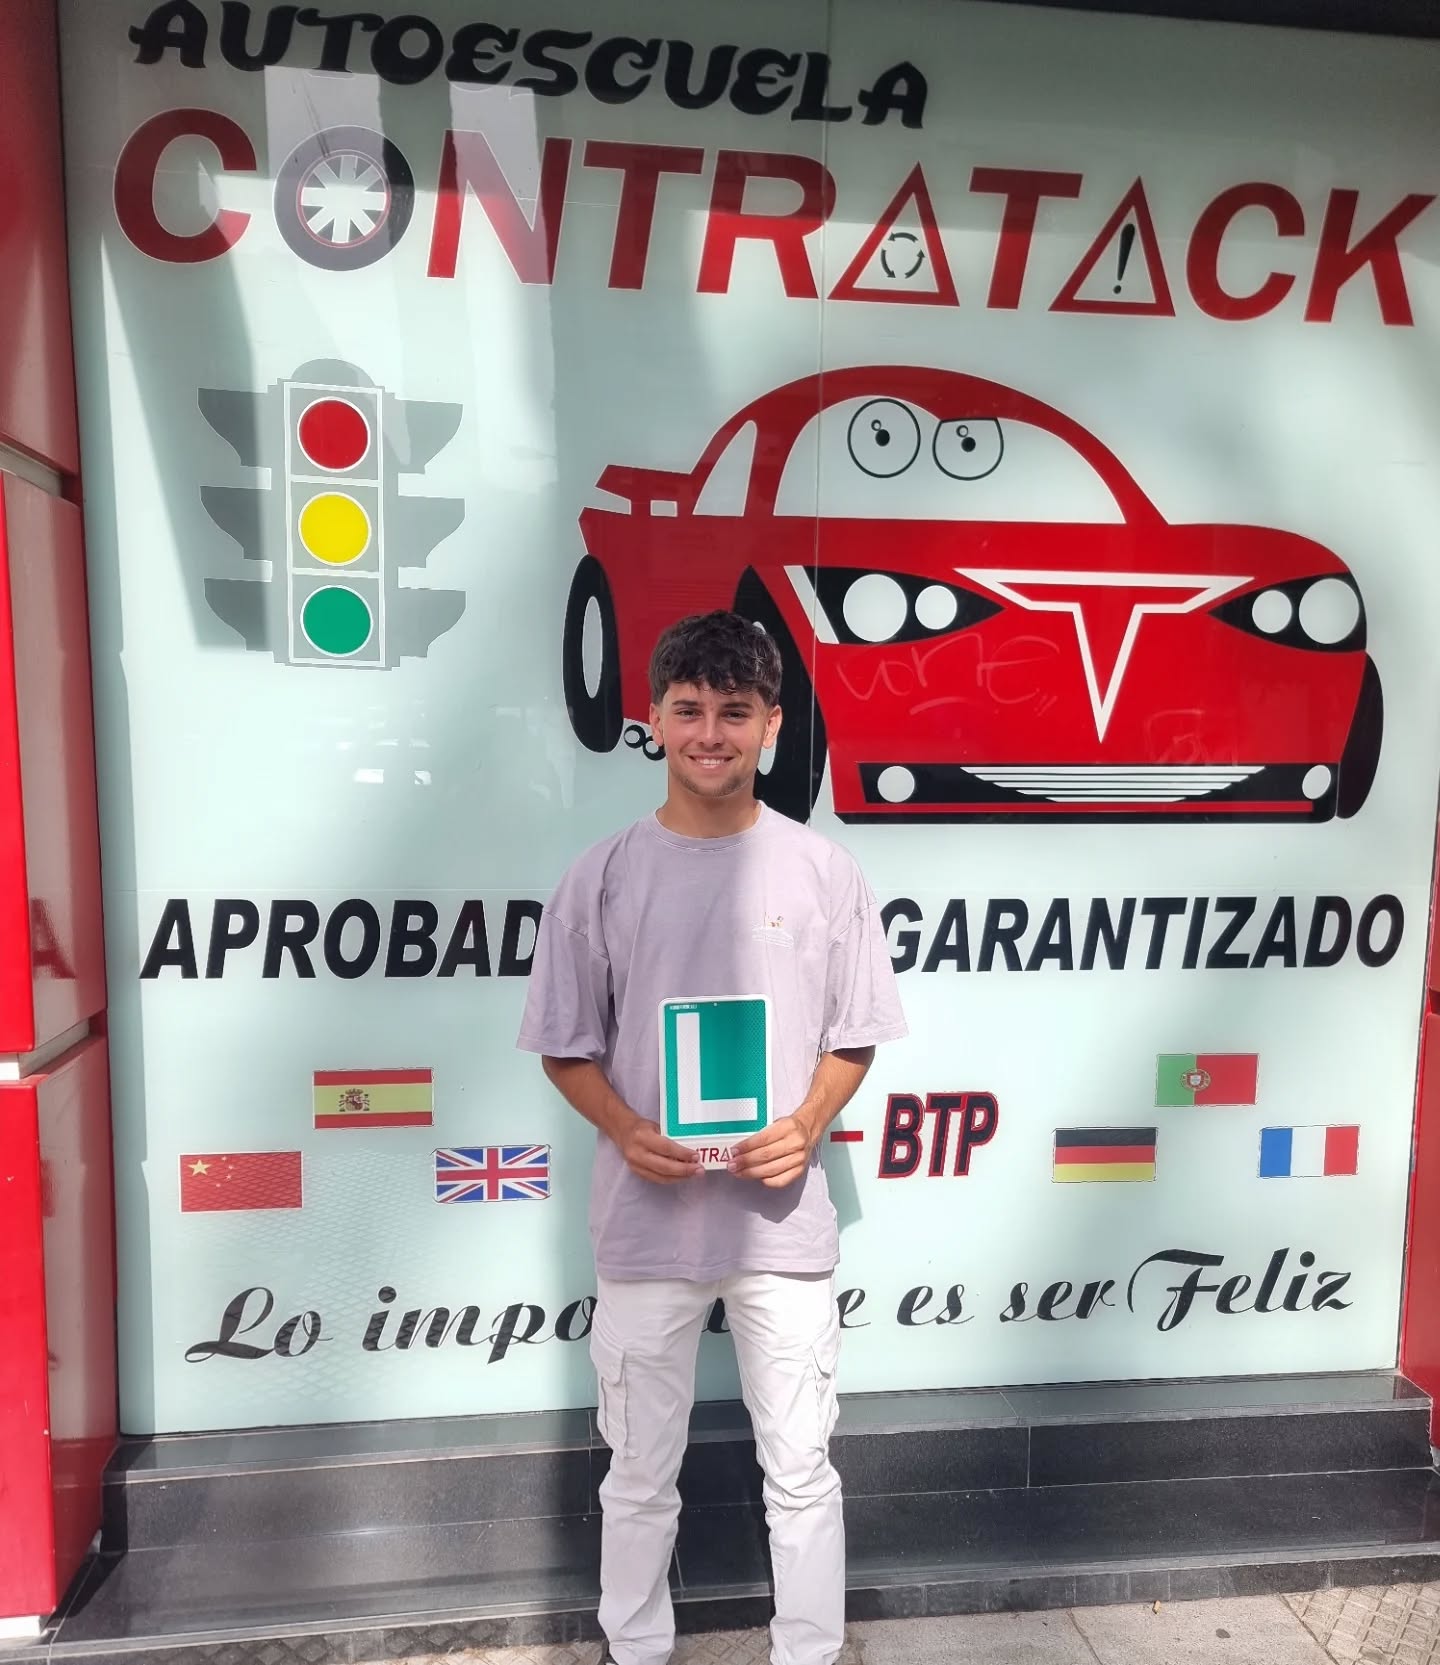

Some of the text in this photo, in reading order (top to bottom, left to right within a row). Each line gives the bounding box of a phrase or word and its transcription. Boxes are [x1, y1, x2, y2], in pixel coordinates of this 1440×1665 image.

[127, 0, 928, 129] AUTOESCUELA
[113, 107, 1436, 327] CONTRATACK
[138, 893, 1406, 980] APROBAD GARANTIZADO
[675, 1011, 758, 1125] L
[696, 1146, 735, 1163] TRA
[878, 1090, 999, 1179] BTP
[185, 1286, 333, 1364] Lo
[896, 1284, 974, 1327] es
[999, 1279, 1117, 1324] ser
[1126, 1246, 1354, 1333] Feliz
